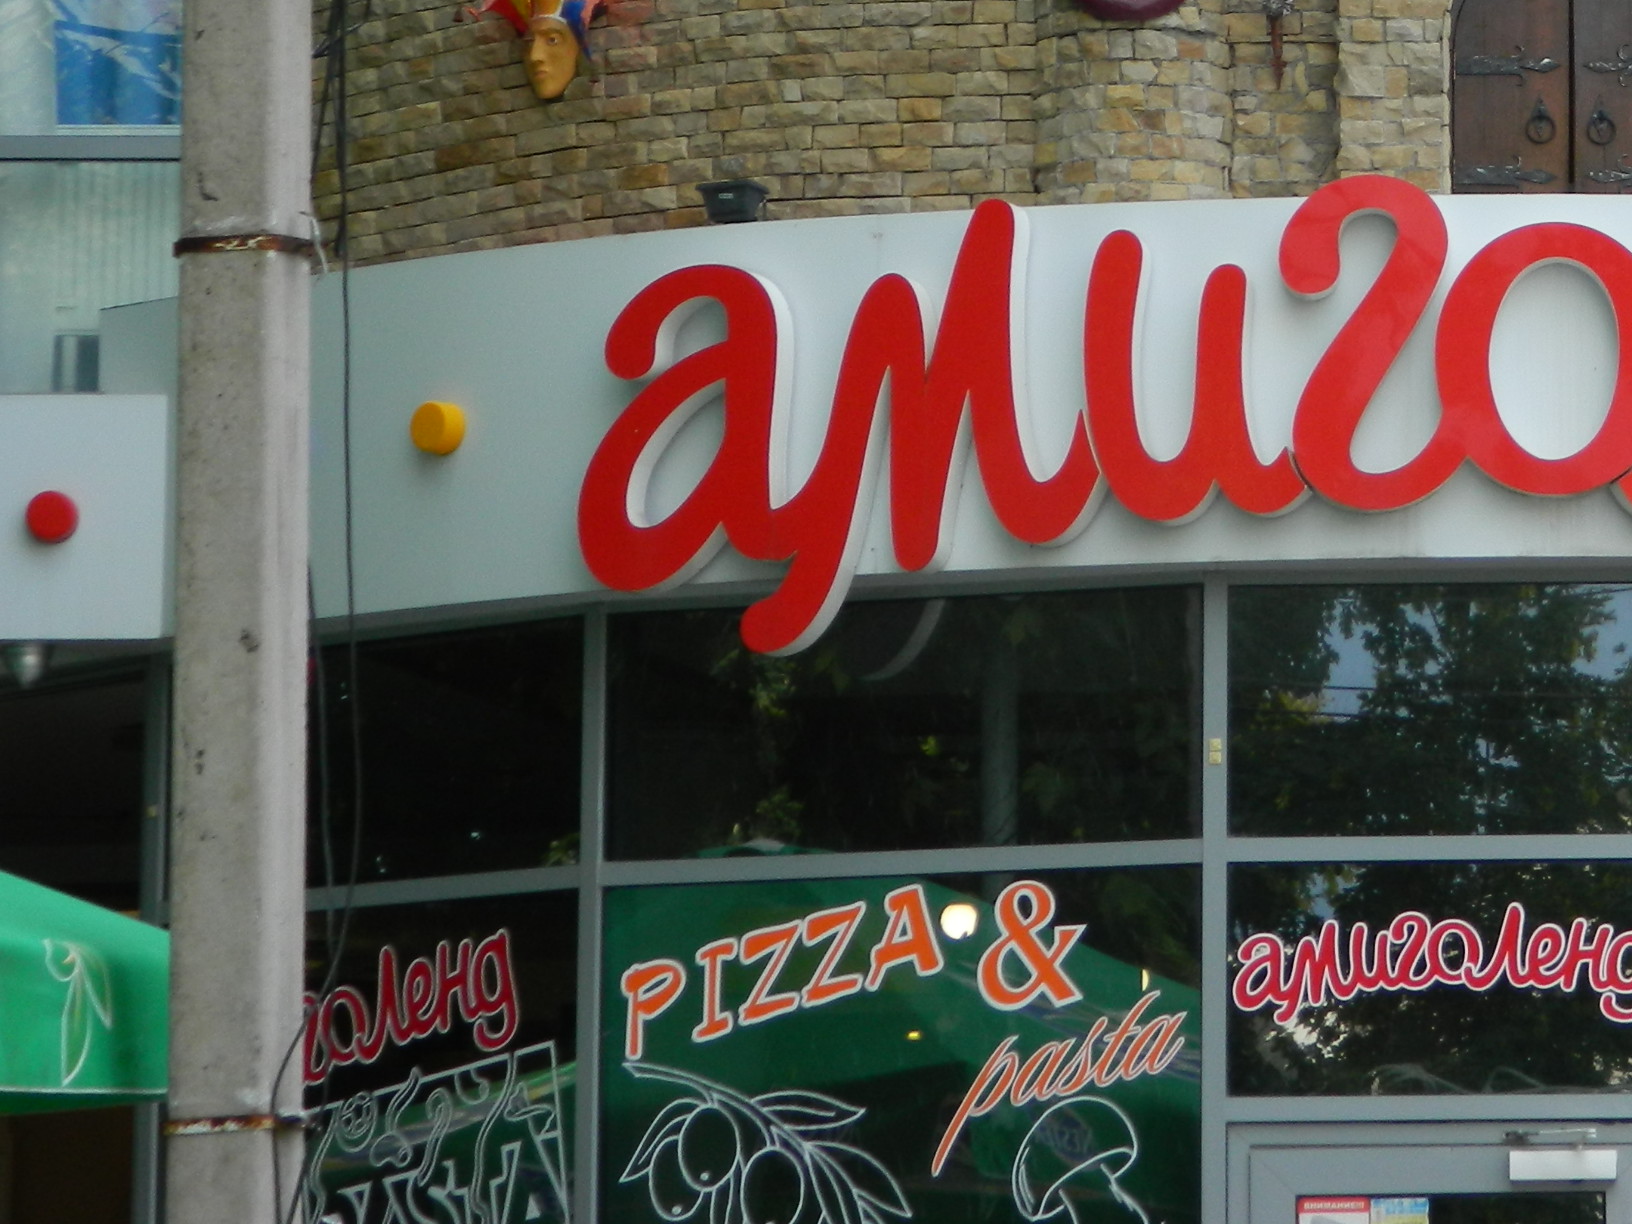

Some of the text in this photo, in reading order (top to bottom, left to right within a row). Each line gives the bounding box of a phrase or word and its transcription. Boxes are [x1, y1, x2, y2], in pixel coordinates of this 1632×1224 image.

[621, 880, 1087, 1061] PIZZA &
[931, 988, 1188, 1176] pasta
